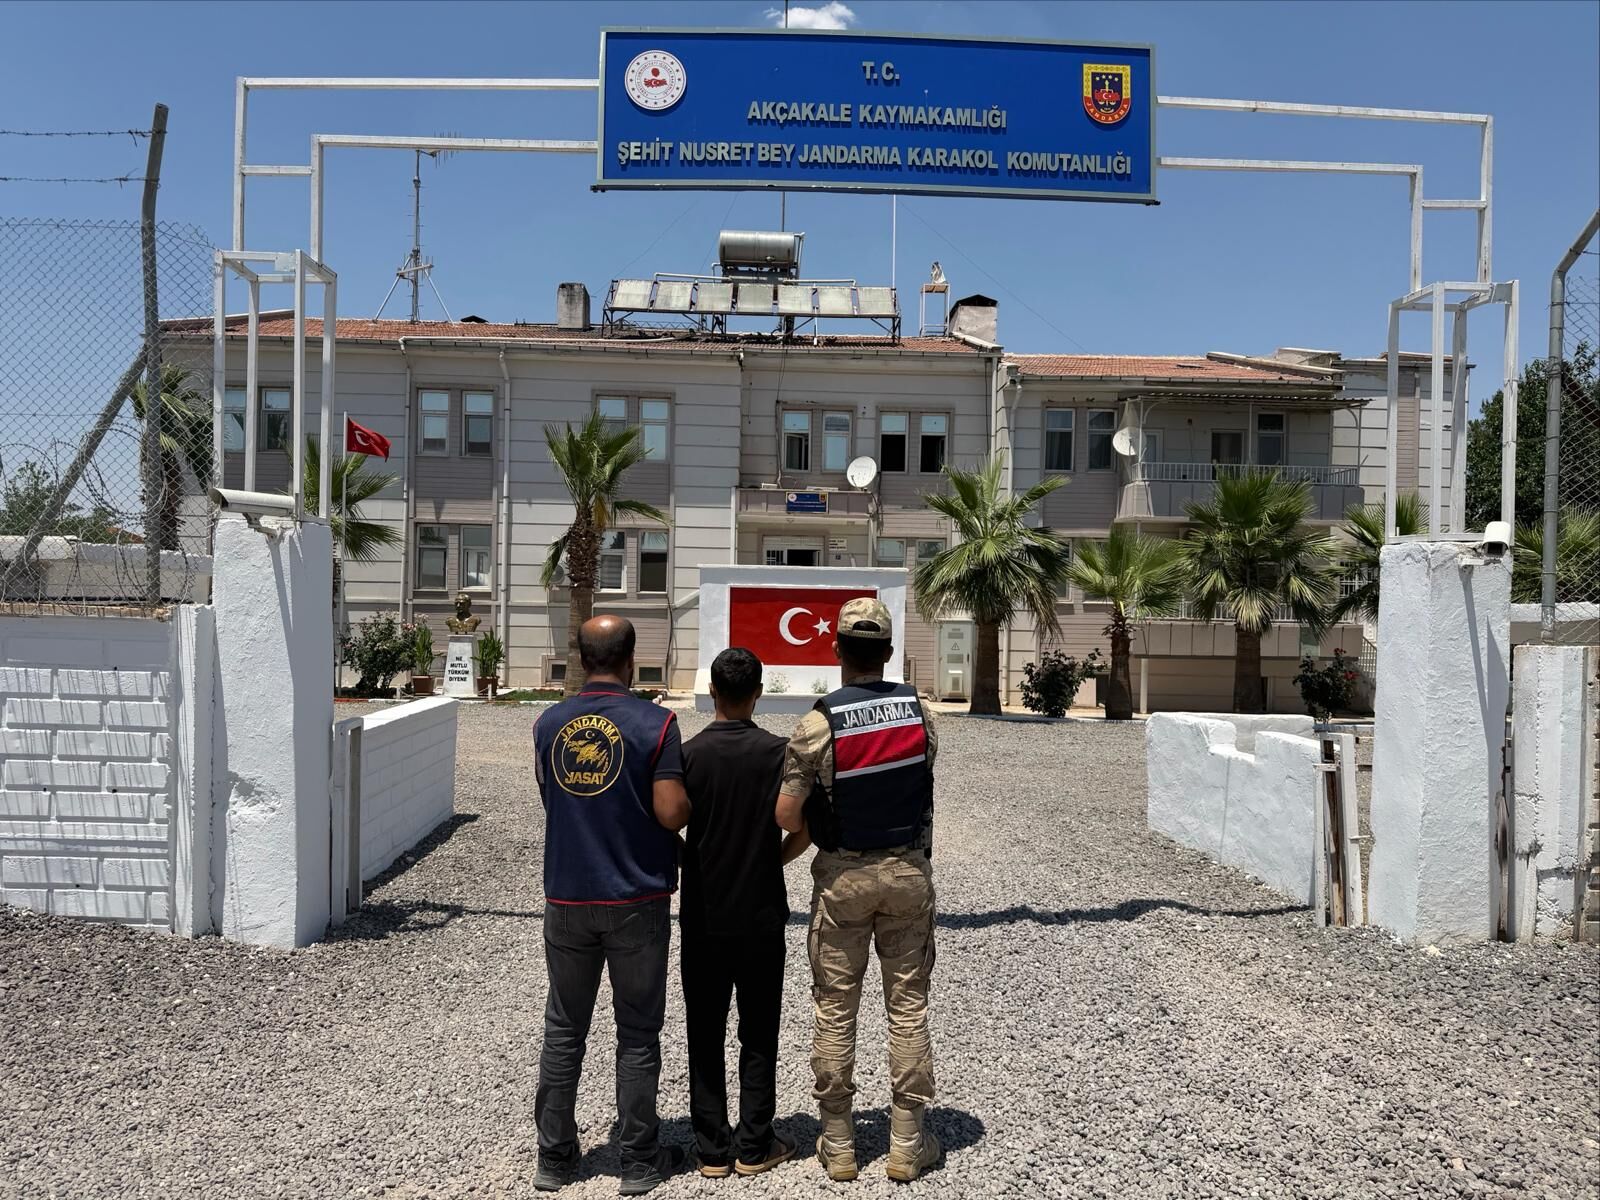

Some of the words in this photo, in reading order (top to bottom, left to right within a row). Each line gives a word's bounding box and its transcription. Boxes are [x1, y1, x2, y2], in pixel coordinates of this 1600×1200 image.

[747, 101, 852, 124] AKÇAKALE
[859, 104, 1007, 128] KAYMAKAMLIĞI
[1086, 102, 1128, 121] JANDARMA
[617, 137, 673, 164] ŞEHİT
[679, 142, 754, 161] NUSRET
[757, 143, 796, 162] BEY
[798, 144, 902, 165] JANDARMA
[908, 147, 999, 169] KARAKOL
[1007, 151, 1131, 174] KOMUTANLIĞI
[842, 702, 916, 728] JANDARMA
[561, 717, 620, 744] JANDARMA
[564, 771, 606, 785] JASAT
